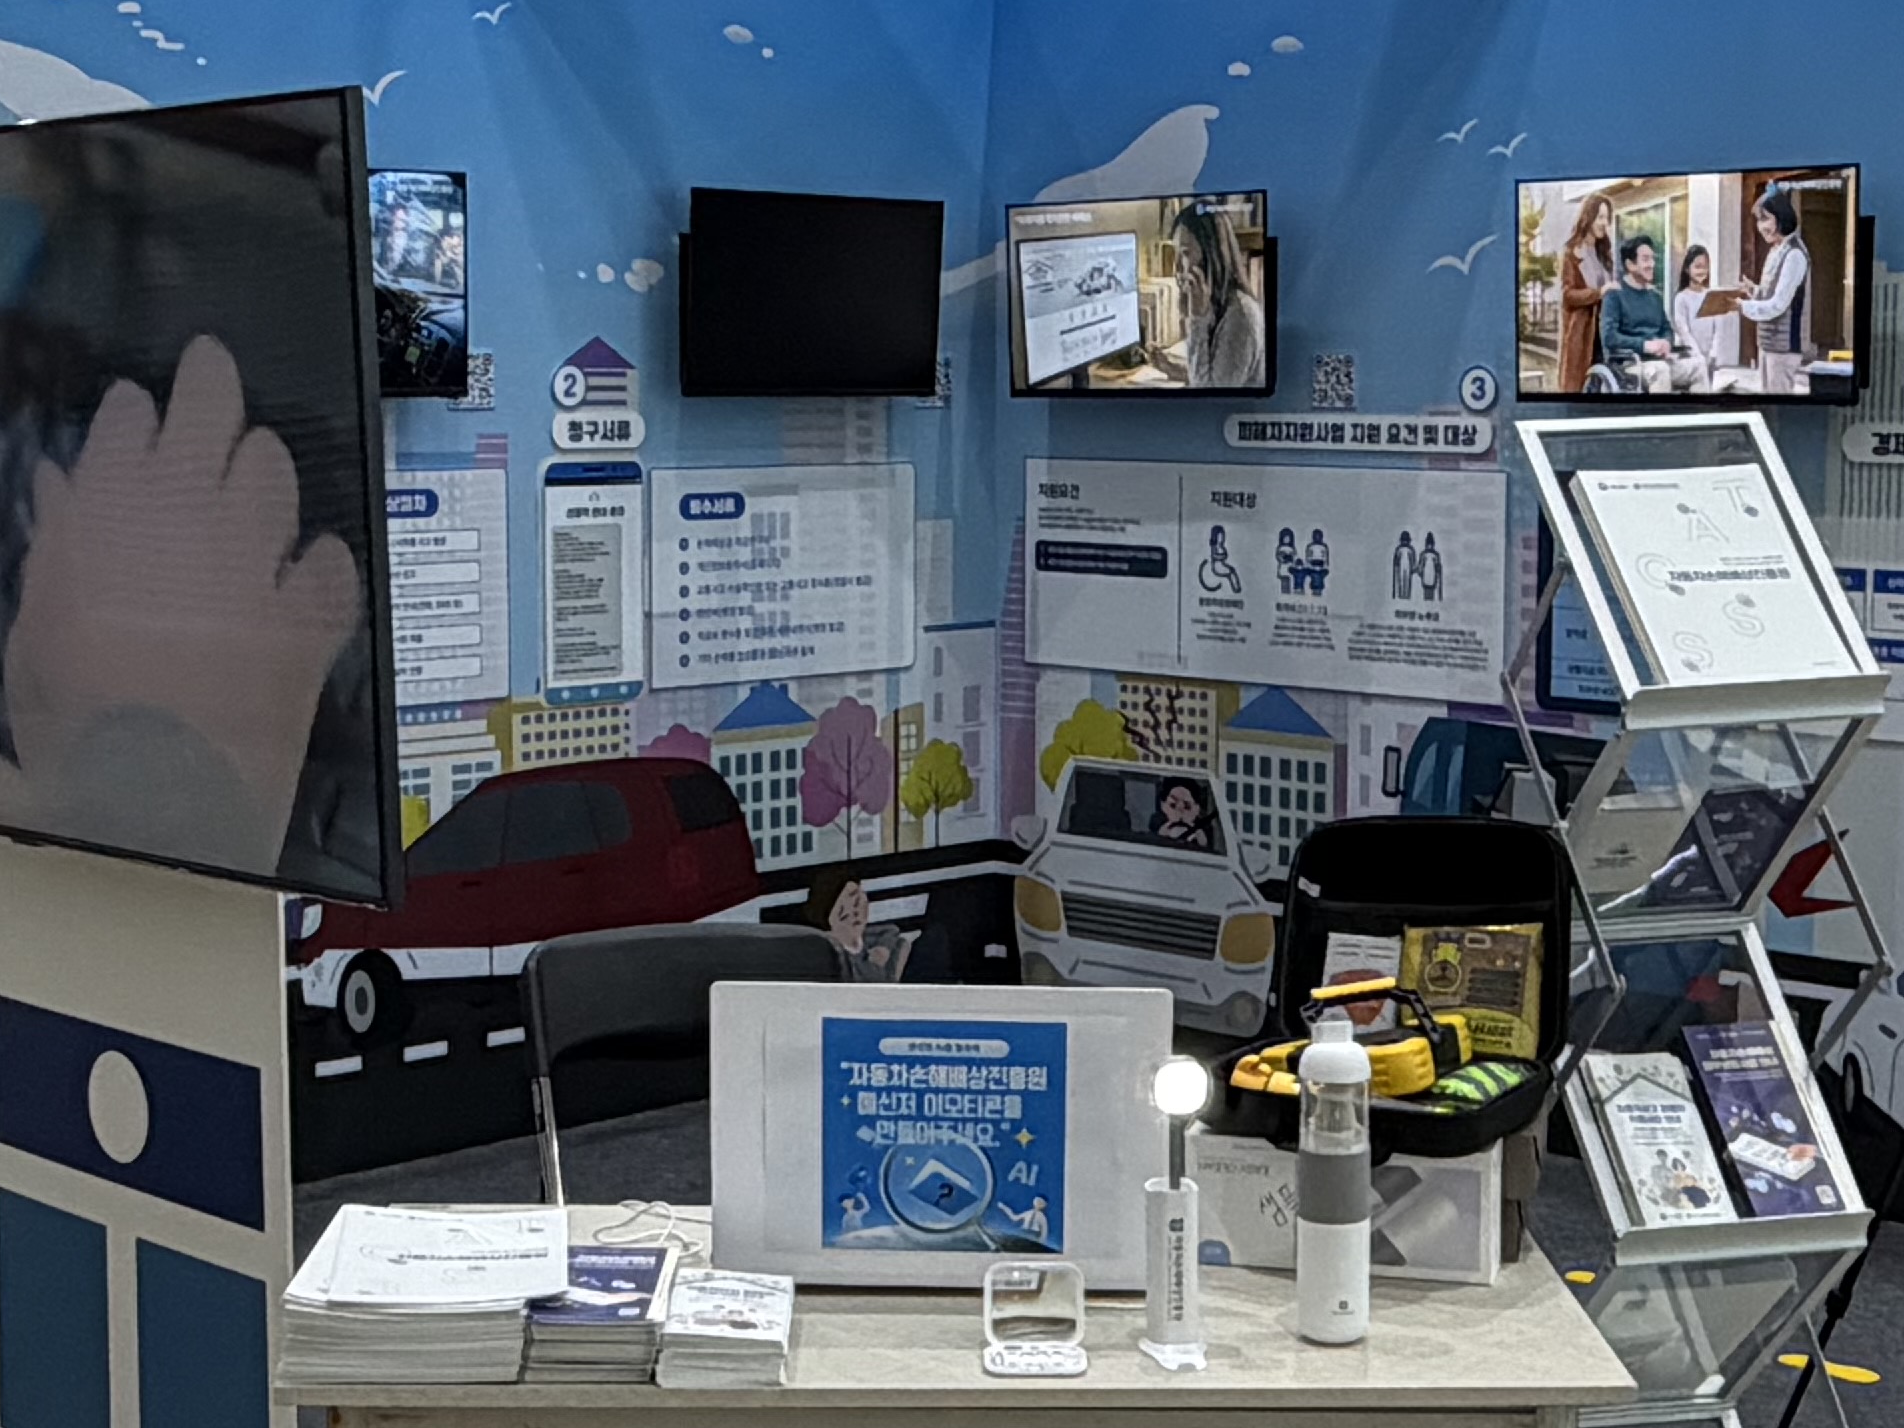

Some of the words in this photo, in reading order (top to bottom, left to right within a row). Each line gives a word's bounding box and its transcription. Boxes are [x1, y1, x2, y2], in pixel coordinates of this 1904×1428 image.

[563, 373, 577, 398] 2
[1471, 377, 1486, 401] 3
[568, 420, 631, 442] 청구서류
[1238, 421, 1345, 444] 피해자지원사업
[1350, 423, 1380, 444] 지원
[1386, 424, 1418, 445] 요건
[1423, 425, 1438, 445] 및
[1444, 425, 1478, 446] 대상
[1008, 1160, 1039, 1187] AI
